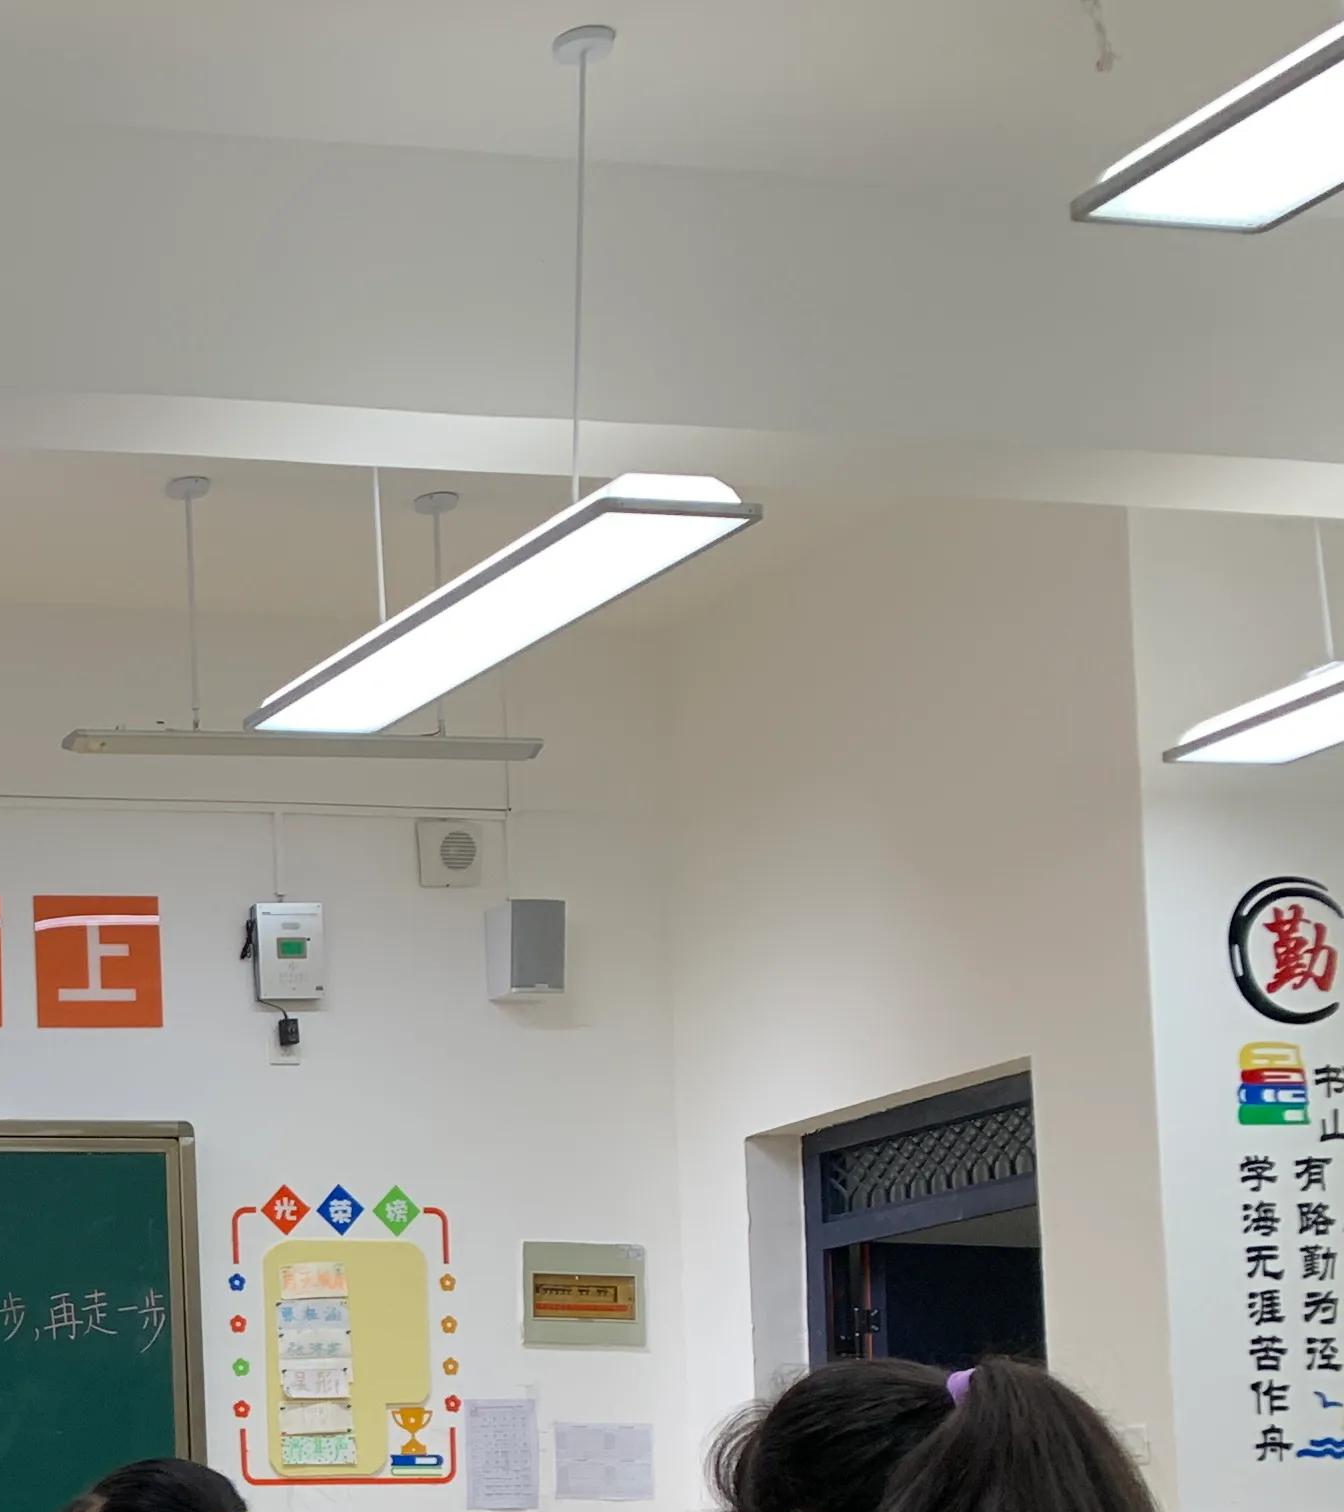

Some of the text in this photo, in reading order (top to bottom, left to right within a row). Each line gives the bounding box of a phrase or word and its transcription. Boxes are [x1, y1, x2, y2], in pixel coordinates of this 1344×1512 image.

[1262, 904, 1338, 993] 勤
[274, 1195, 408, 1225] 光荣榜
[1240, 1155, 1294, 1462] 学海无涯苦作舟
